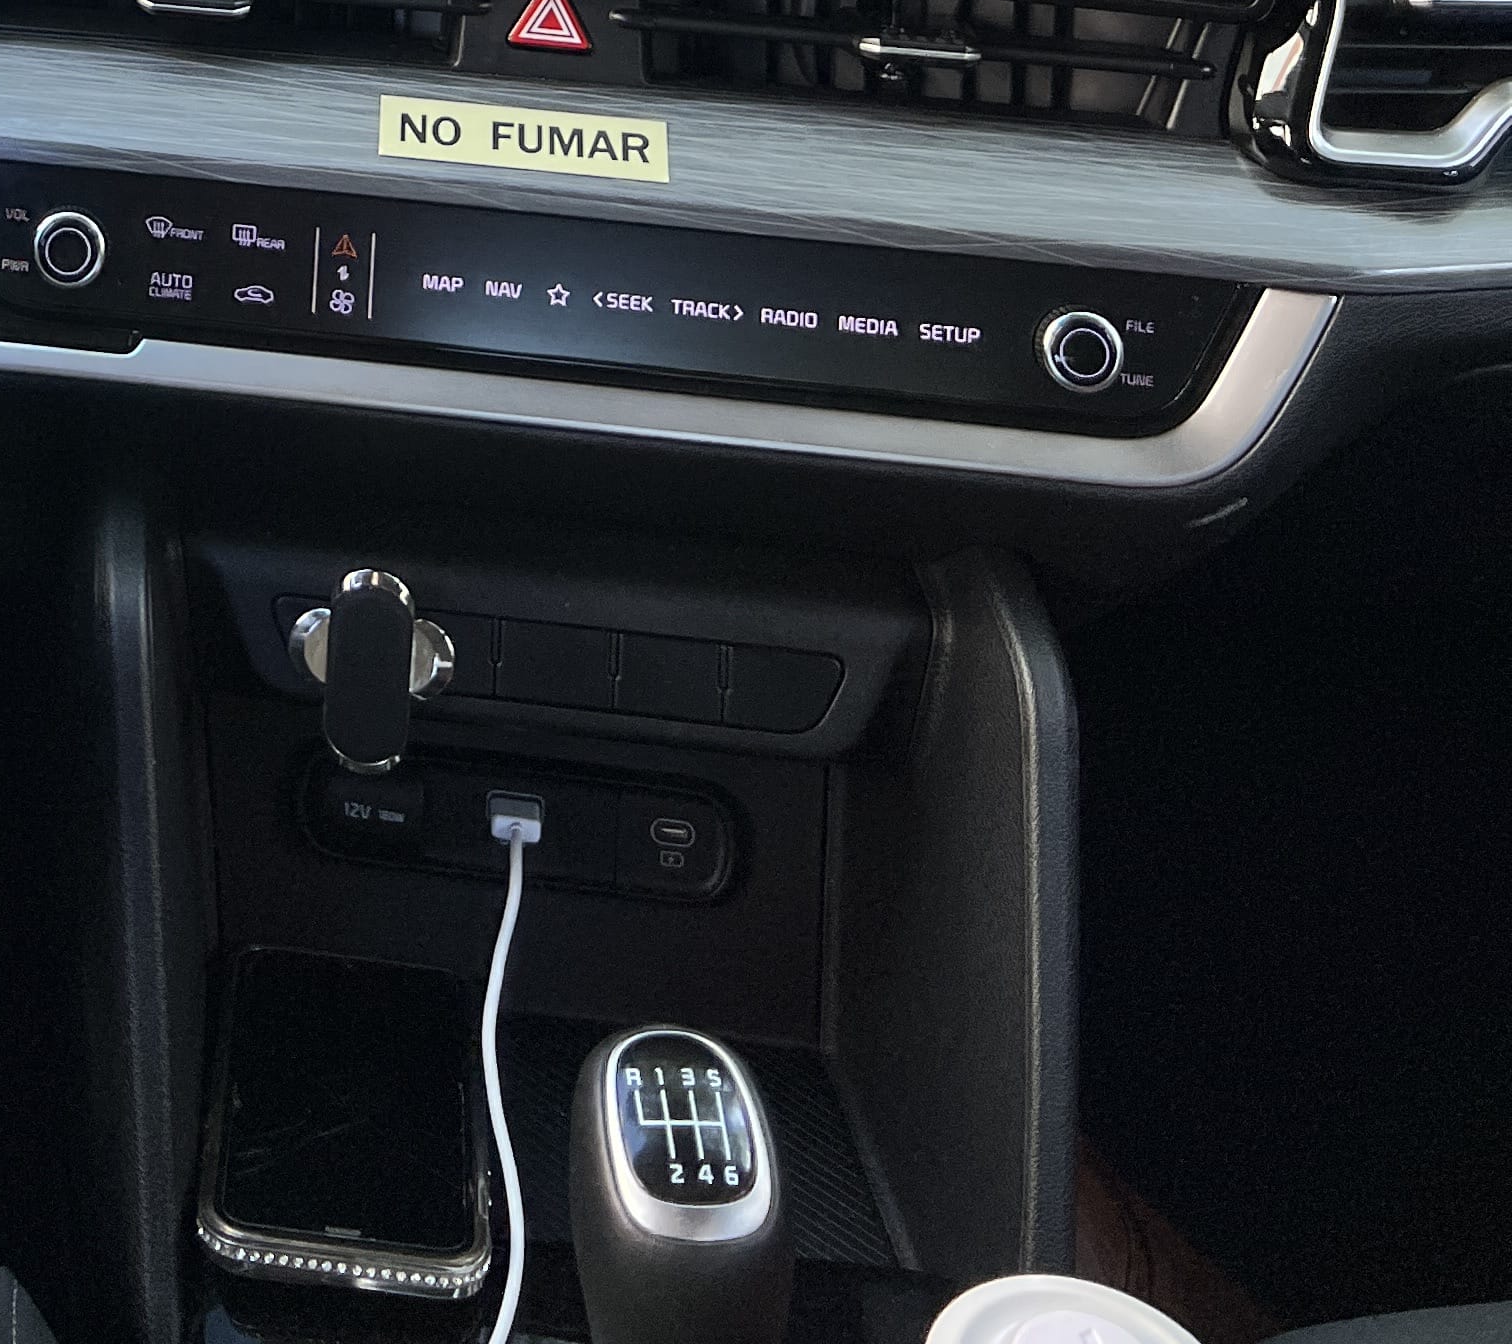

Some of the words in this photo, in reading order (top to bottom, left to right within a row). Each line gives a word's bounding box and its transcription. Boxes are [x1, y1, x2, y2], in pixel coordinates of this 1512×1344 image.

[399, 112, 462, 146] NO
[491, 120, 651, 164] FUMAR
[5, 207, 30, 222] VOL
[169, 227, 204, 241] FRONT
[256, 237, 286, 251] REAR
[1, 258, 29, 272] PWR
[150, 271, 193, 289] AUTO
[422, 273, 464, 293] MAP
[485, 279, 523, 299] NAV
[148, 286, 193, 301] CLIMATE
[760, 307, 818, 329] RADIO
[838, 315, 899, 337] MEDIA
[1125, 319, 1155, 333] FILE
[919, 323, 981, 344] SETUP
[1120, 372, 1154, 387] TUNE
[344, 802, 372, 819] 12V
[625, 1067, 642, 1086] R
[654, 1066, 665, 1086] 1
[680, 1067, 696, 1086] 3
[706, 1068, 722, 1087] 5
[669, 1163, 685, 1184] 2
[697, 1163, 715, 1185] 4
[723, 1165, 739, 1185] 6
